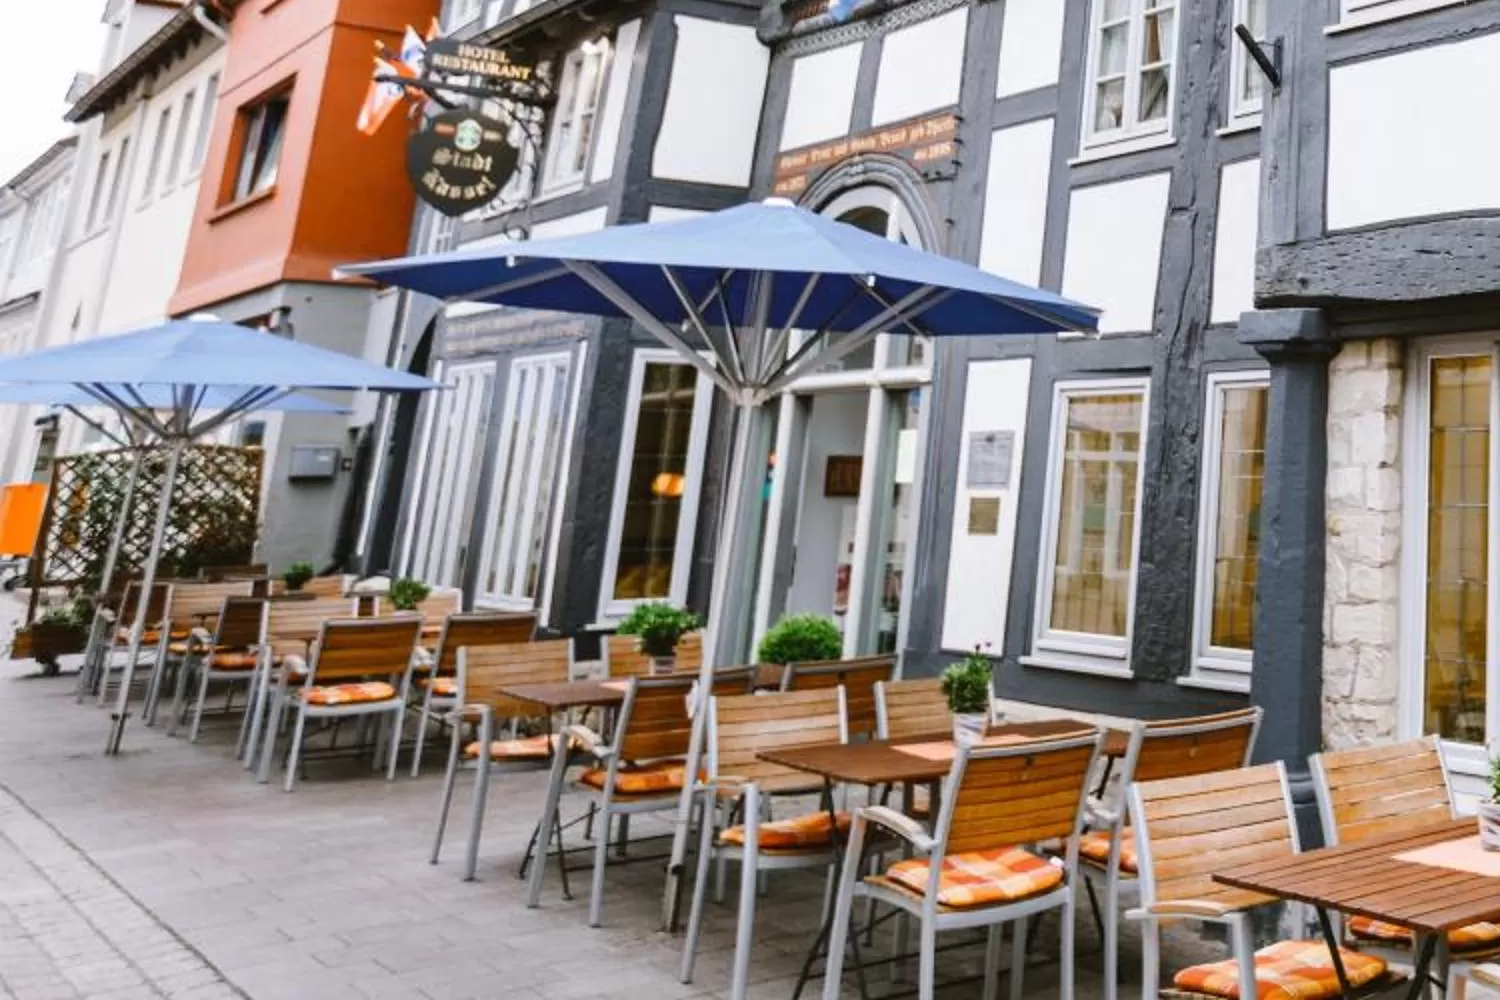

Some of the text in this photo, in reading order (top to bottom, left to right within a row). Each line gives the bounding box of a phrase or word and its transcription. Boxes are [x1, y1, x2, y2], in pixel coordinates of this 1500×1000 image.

[458, 44, 509, 62] HOTEL
[432, 54, 532, 80] RESTAURANT
[432, 147, 494, 173] Stadt
